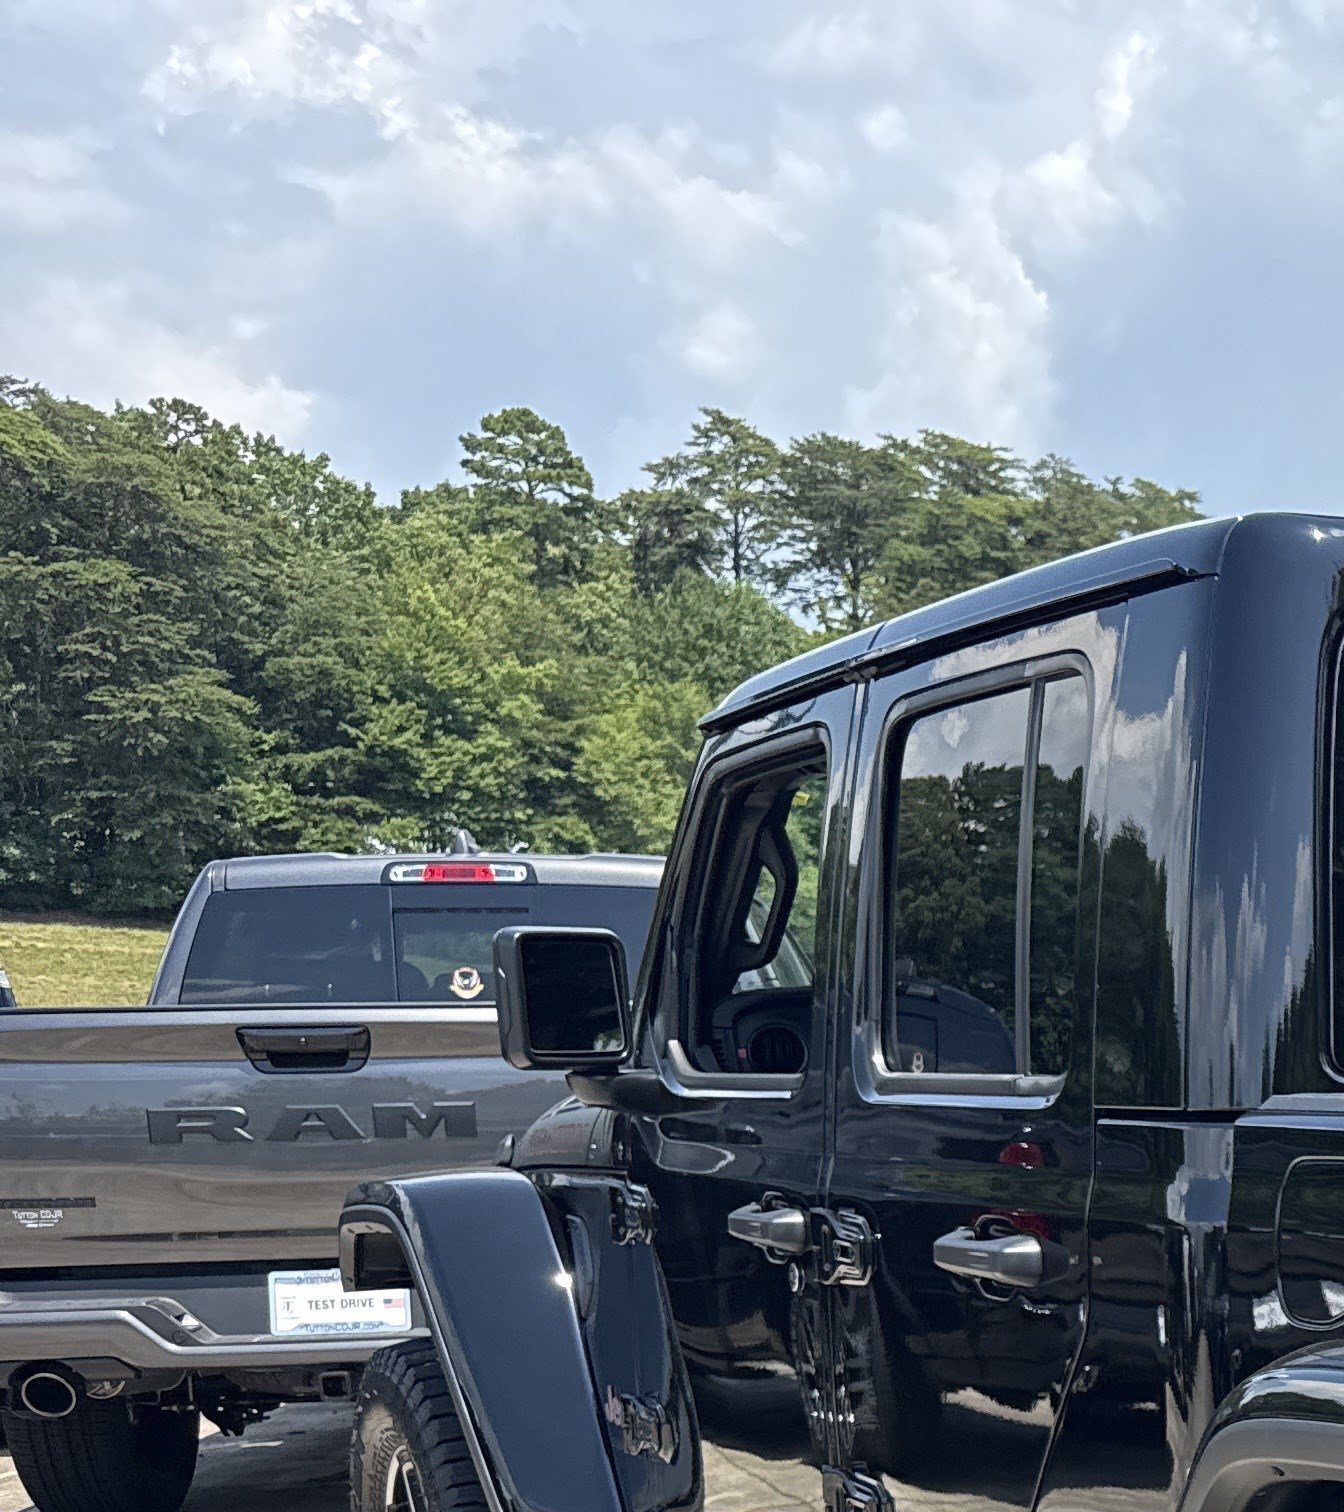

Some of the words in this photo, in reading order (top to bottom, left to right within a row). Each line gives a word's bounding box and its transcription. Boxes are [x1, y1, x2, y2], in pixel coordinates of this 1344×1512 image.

[146, 1101, 477, 1145] RAM
[307, 1299, 336, 1311] TEST
[340, 1297, 375, 1309] DRIVE
